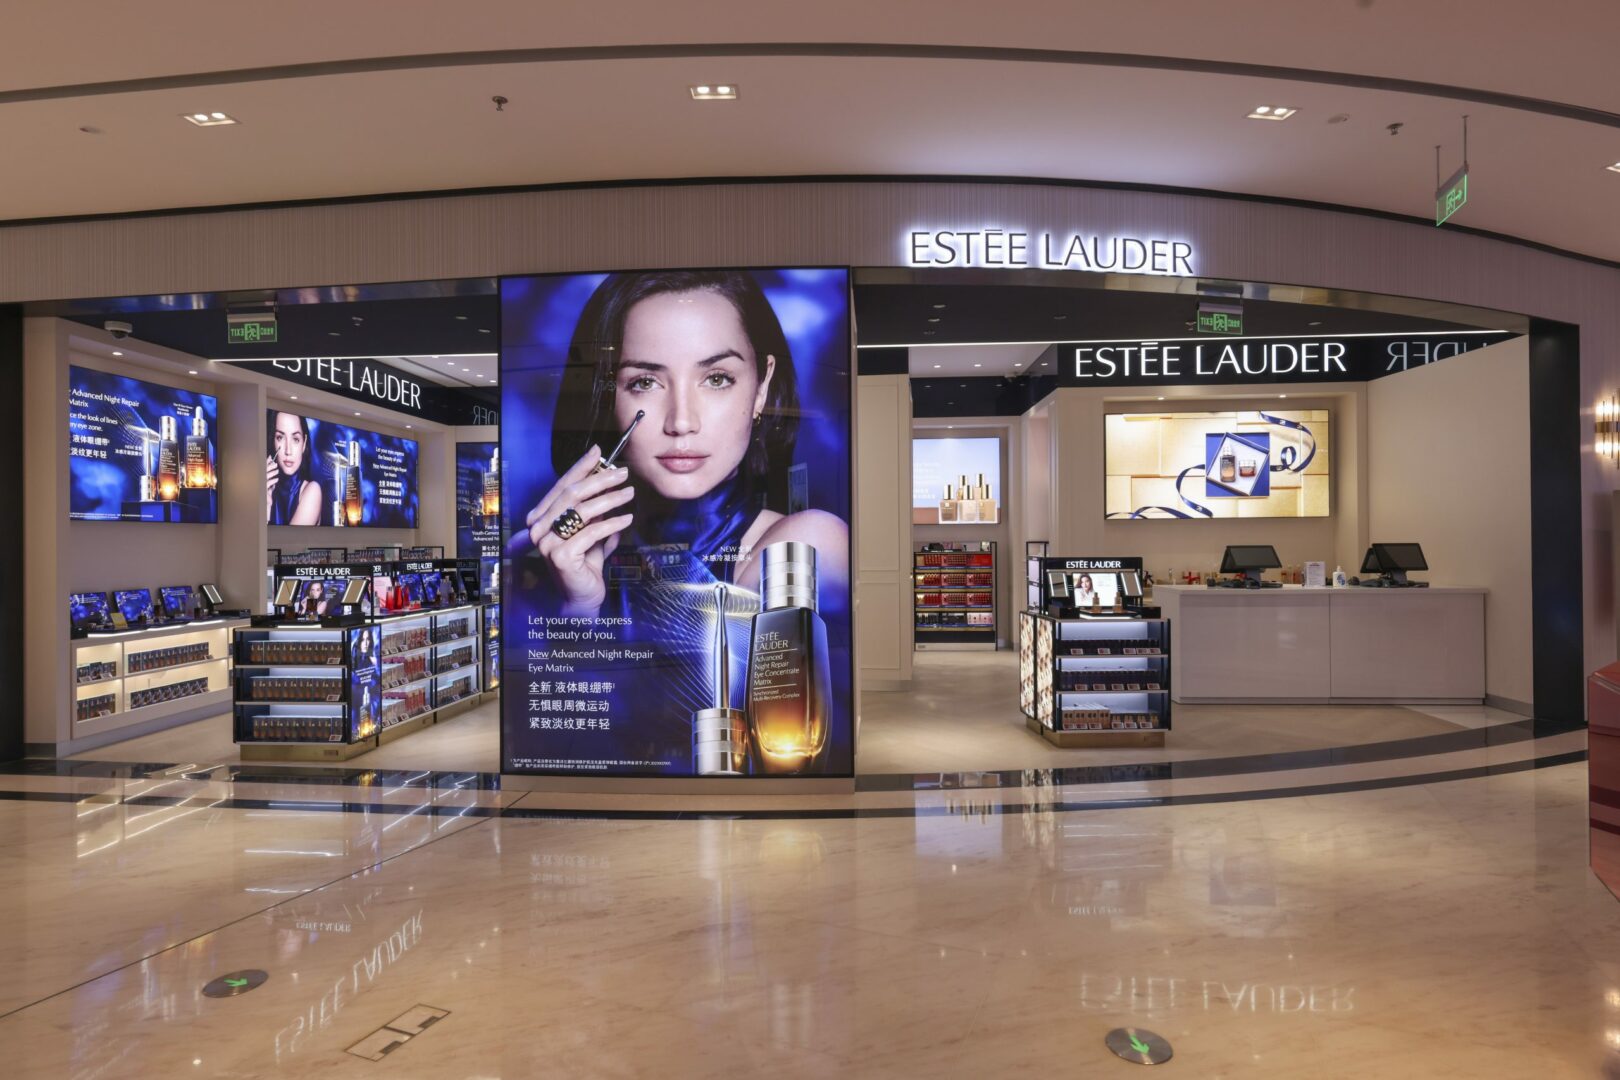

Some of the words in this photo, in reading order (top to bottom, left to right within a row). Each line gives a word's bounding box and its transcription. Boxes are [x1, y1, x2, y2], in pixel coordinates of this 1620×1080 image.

[1044, 233, 1194, 274] LAUDER
[1195, 343, 1348, 375] LAUDER
[349, 361, 422, 410] LAUDER
[72, 388, 103, 401] Advanced
[104, 395, 121, 405] Night
[121, 397, 140, 408] Repair
[77, 412, 87, 420] the
[87, 414, 100, 423] look
[100, 416, 106, 424] of
[106, 417, 118, 425] lines
[1090, 560, 1121, 568] LAUDER
[319, 567, 351, 576] LAUDER
[528, 615, 543, 625] Let
[546, 616, 568, 627] your
[570, 616, 593, 627] eyes
[595, 616, 633, 627] express
[528, 629, 544, 639] the
[546, 629, 580, 642] beauty
[582, 629, 592, 640] of
[593, 631, 616, 642] you.
[755, 640, 789, 651] LAUDER
[528, 649, 549, 659] New
[551, 649, 595, 659] Advanced
[597, 649, 623, 661] Night
[624, 649, 653, 660] Repair
[755, 653, 783, 662] Advanced
[528, 664, 544, 674] Eye
[545, 663, 574, 673] Matrix
[771, 661, 790, 669] Repair
[754, 671, 764, 679] Eye
[765, 668, 800, 677] Concentrate
[528, 681, 552, 694] 全新
[528, 699, 610, 712] 无惧眼周微运动
[529, 717, 611, 730] 紧致淡纹更年轻
